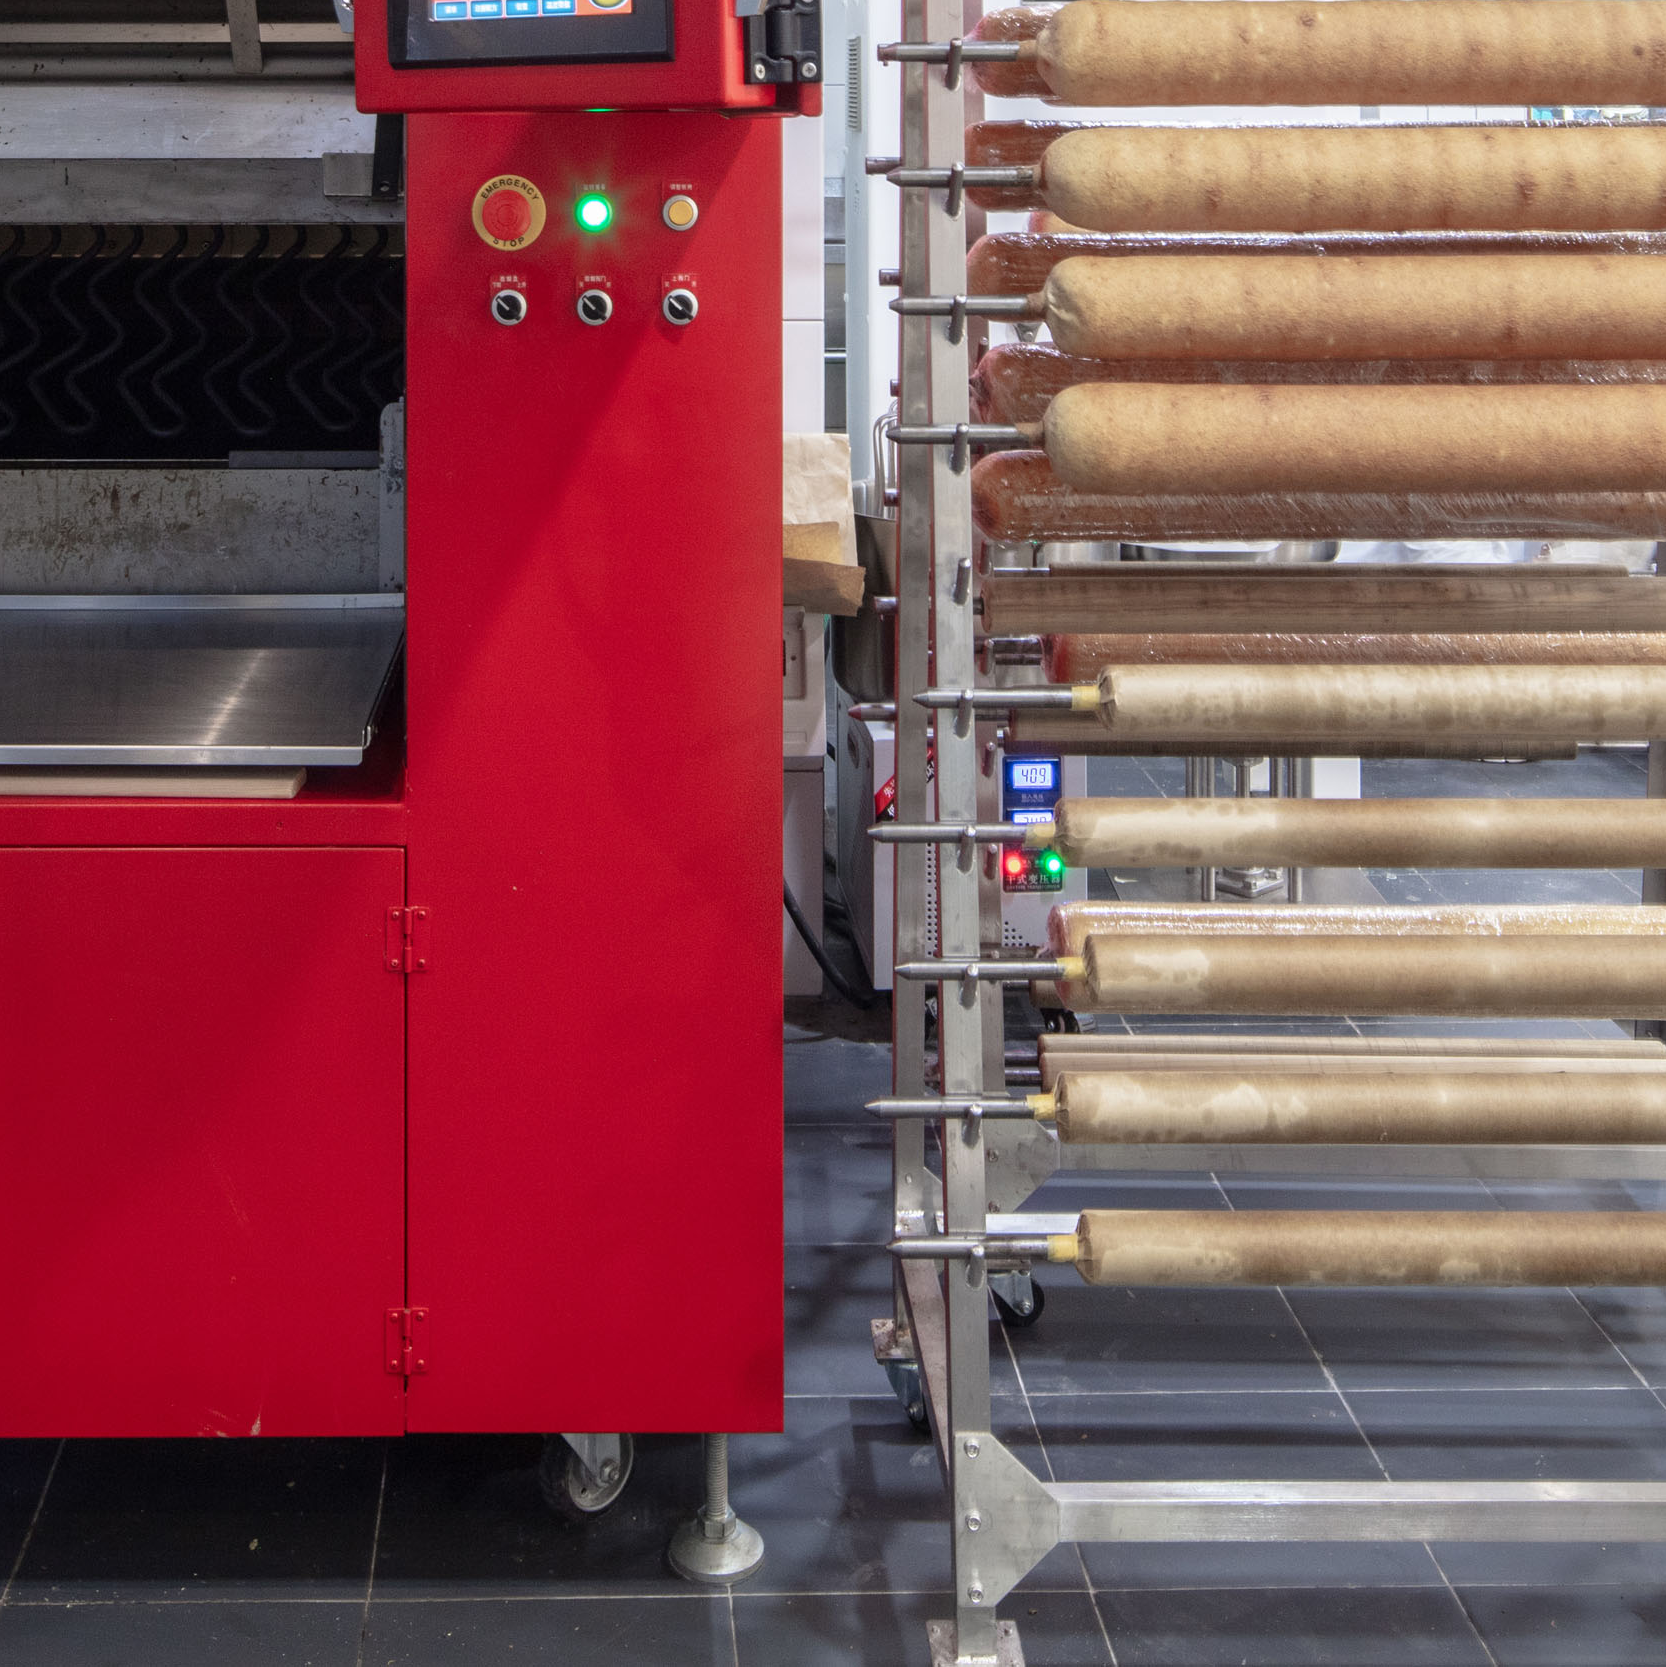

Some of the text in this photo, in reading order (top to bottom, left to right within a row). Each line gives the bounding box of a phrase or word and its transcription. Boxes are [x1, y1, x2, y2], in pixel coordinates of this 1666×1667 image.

[481, 178, 540, 200] EMERGENCY
[1021, 767, 1047, 784] 409
[1006, 874, 1060, 884] 干式变压器
